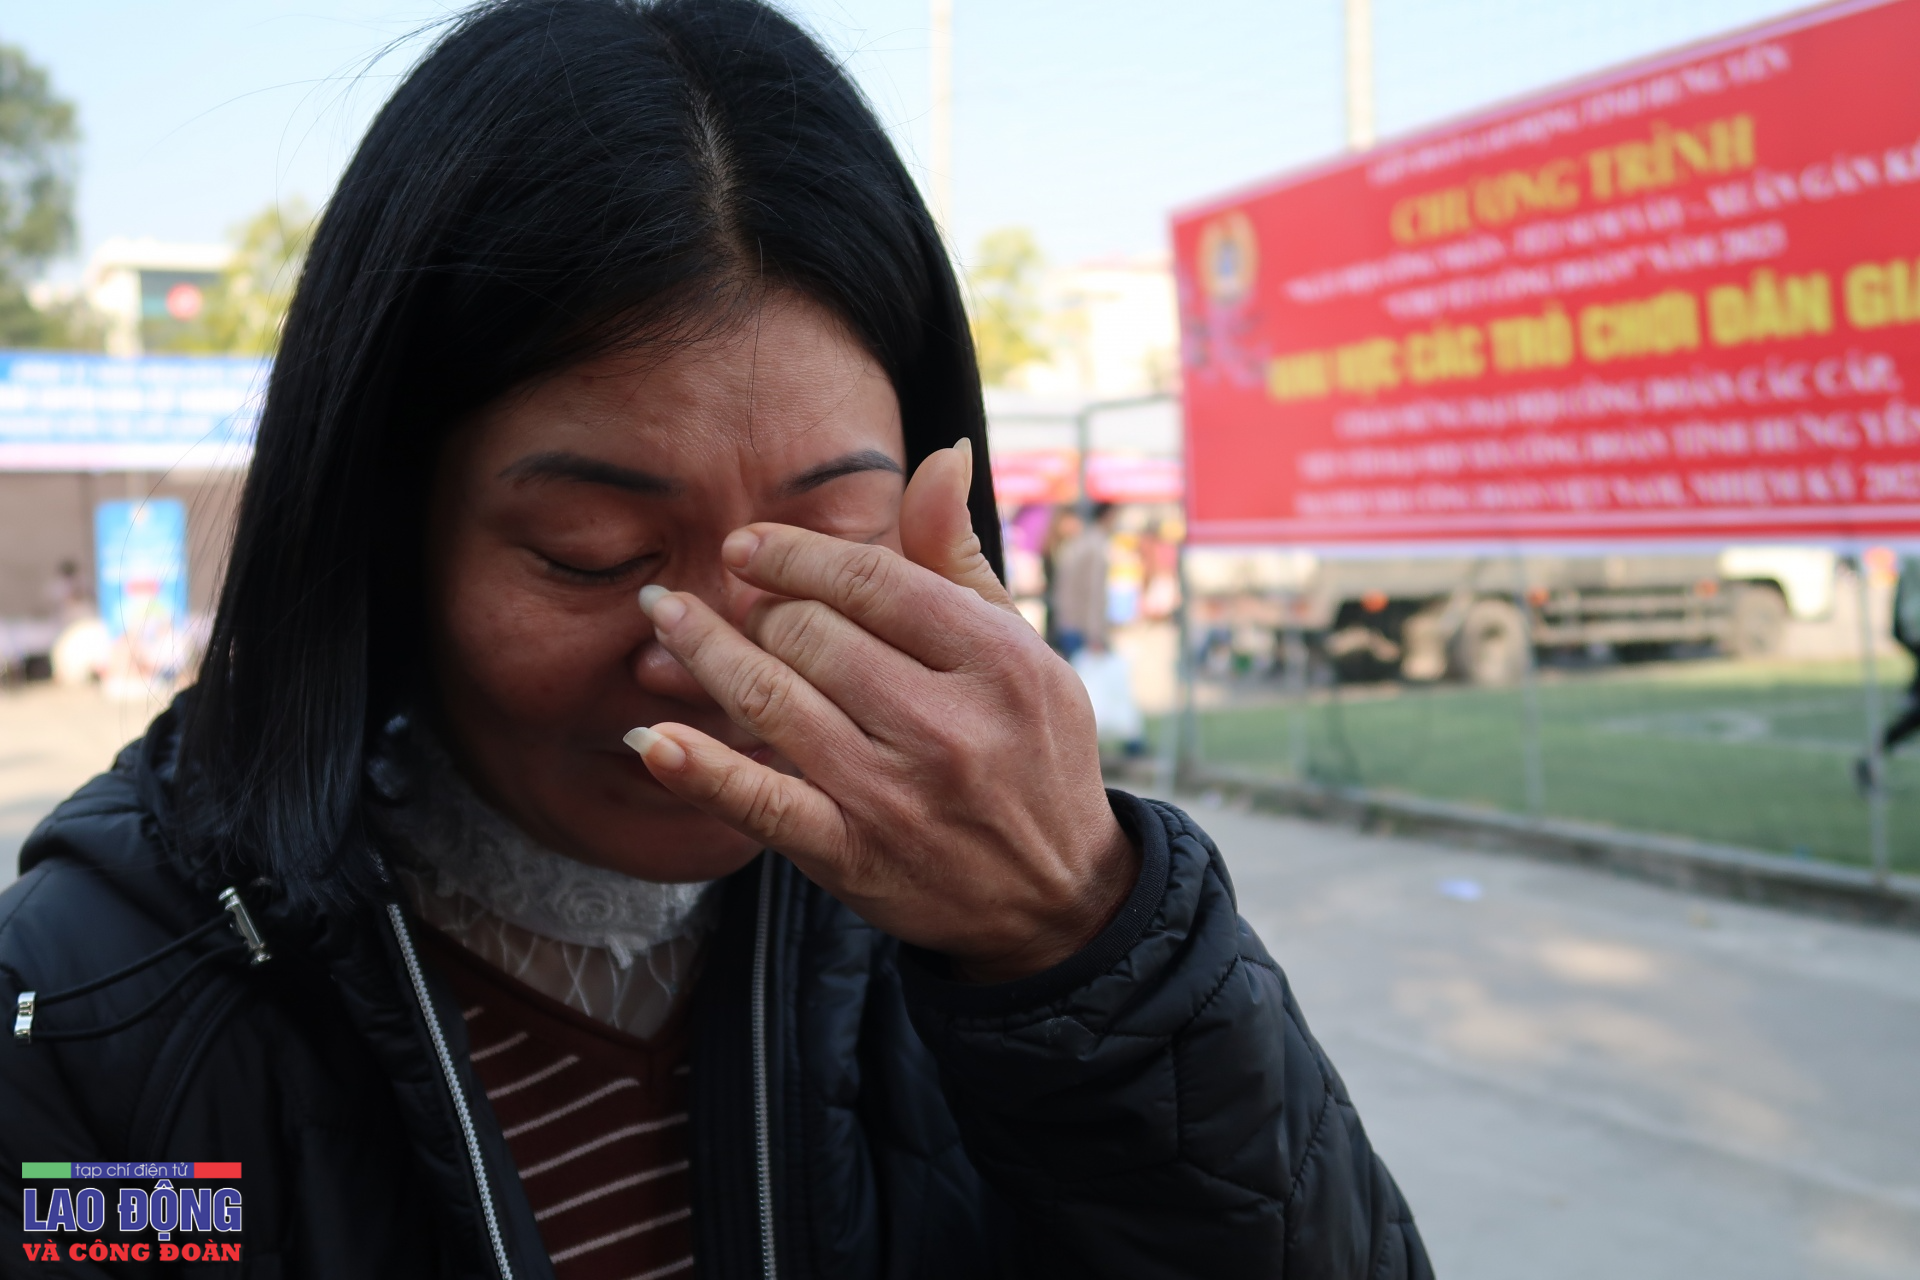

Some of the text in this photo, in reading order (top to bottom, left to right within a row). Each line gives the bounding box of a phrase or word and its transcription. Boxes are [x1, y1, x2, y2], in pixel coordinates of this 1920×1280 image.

[1391, 162, 1580, 244] CHƯƠNG
[1588, 113, 1755, 200] TRÌNH
[1490, 304, 1574, 374] TRÒ
[1580, 290, 1701, 362] CHƠI
[1707, 270, 1834, 348] DÂN
